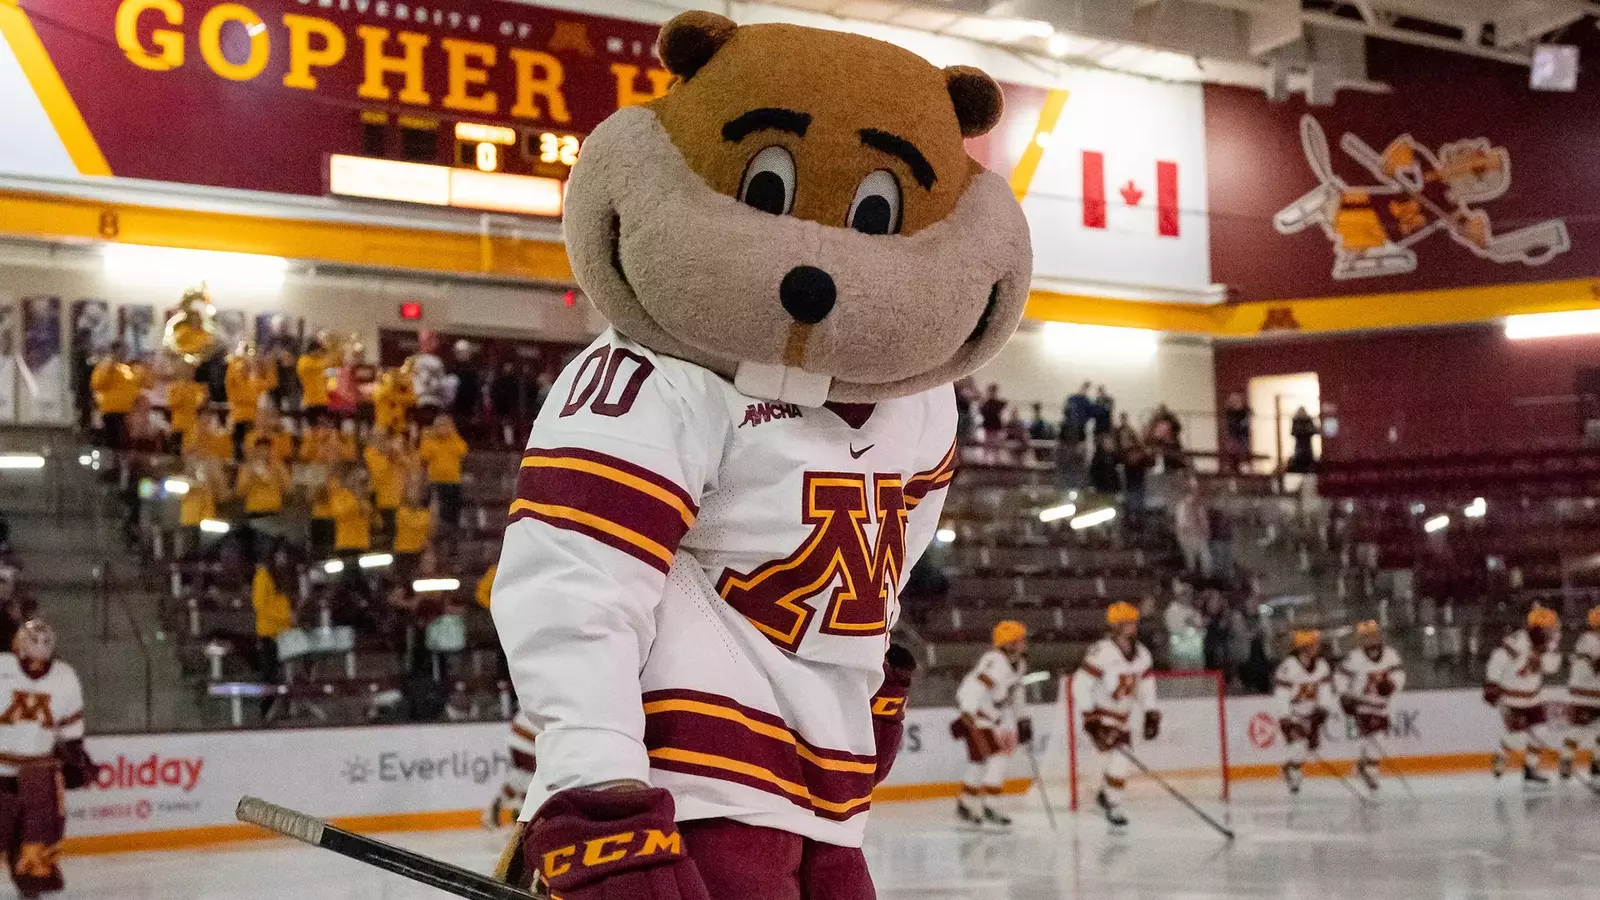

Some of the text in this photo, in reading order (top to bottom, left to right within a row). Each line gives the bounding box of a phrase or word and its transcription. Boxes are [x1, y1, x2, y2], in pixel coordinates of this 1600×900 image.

[500, 19, 532, 39] OF
[114, 0, 572, 123] GOPHER
[559, 343, 656, 418] 00
[740, 402, 804, 427] WCHA
[96, 753, 204, 792] oliday
[378, 751, 512, 784] Everligh
[542, 829, 682, 878] CCM
